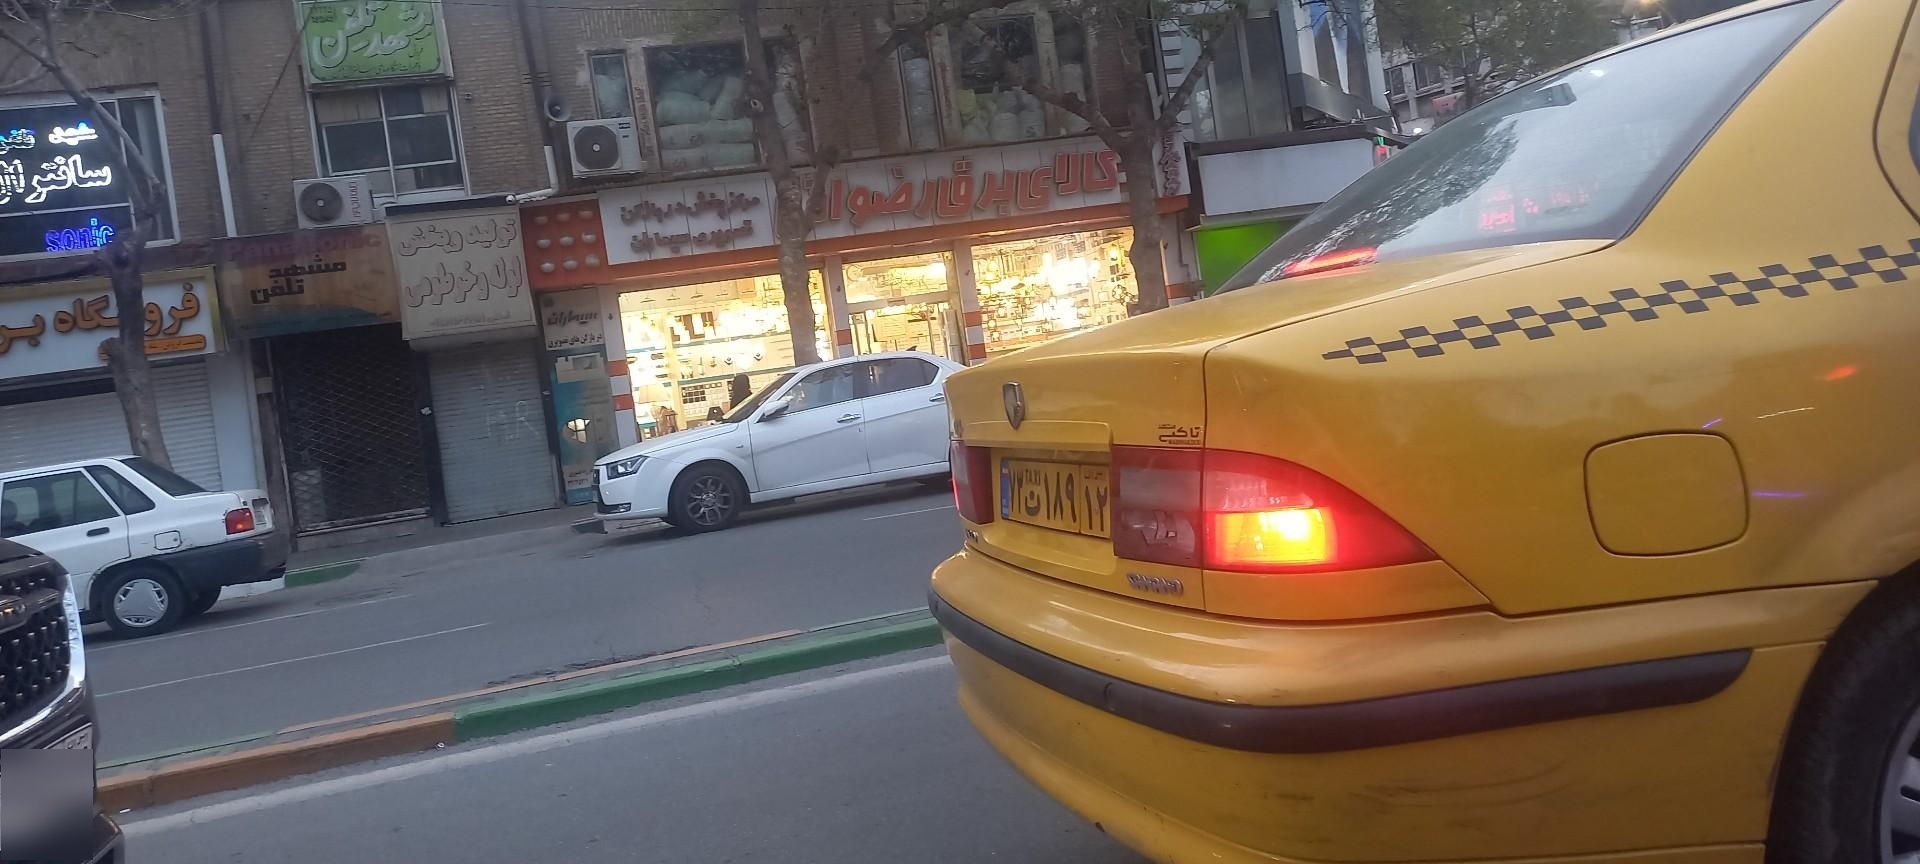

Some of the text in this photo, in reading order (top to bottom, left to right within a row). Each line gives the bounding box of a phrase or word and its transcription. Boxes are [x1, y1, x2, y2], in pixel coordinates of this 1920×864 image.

[268, 253, 347, 279] مشهد
[250, 276, 305, 305] تلفن
[54, 281, 200, 338] فروگاه
